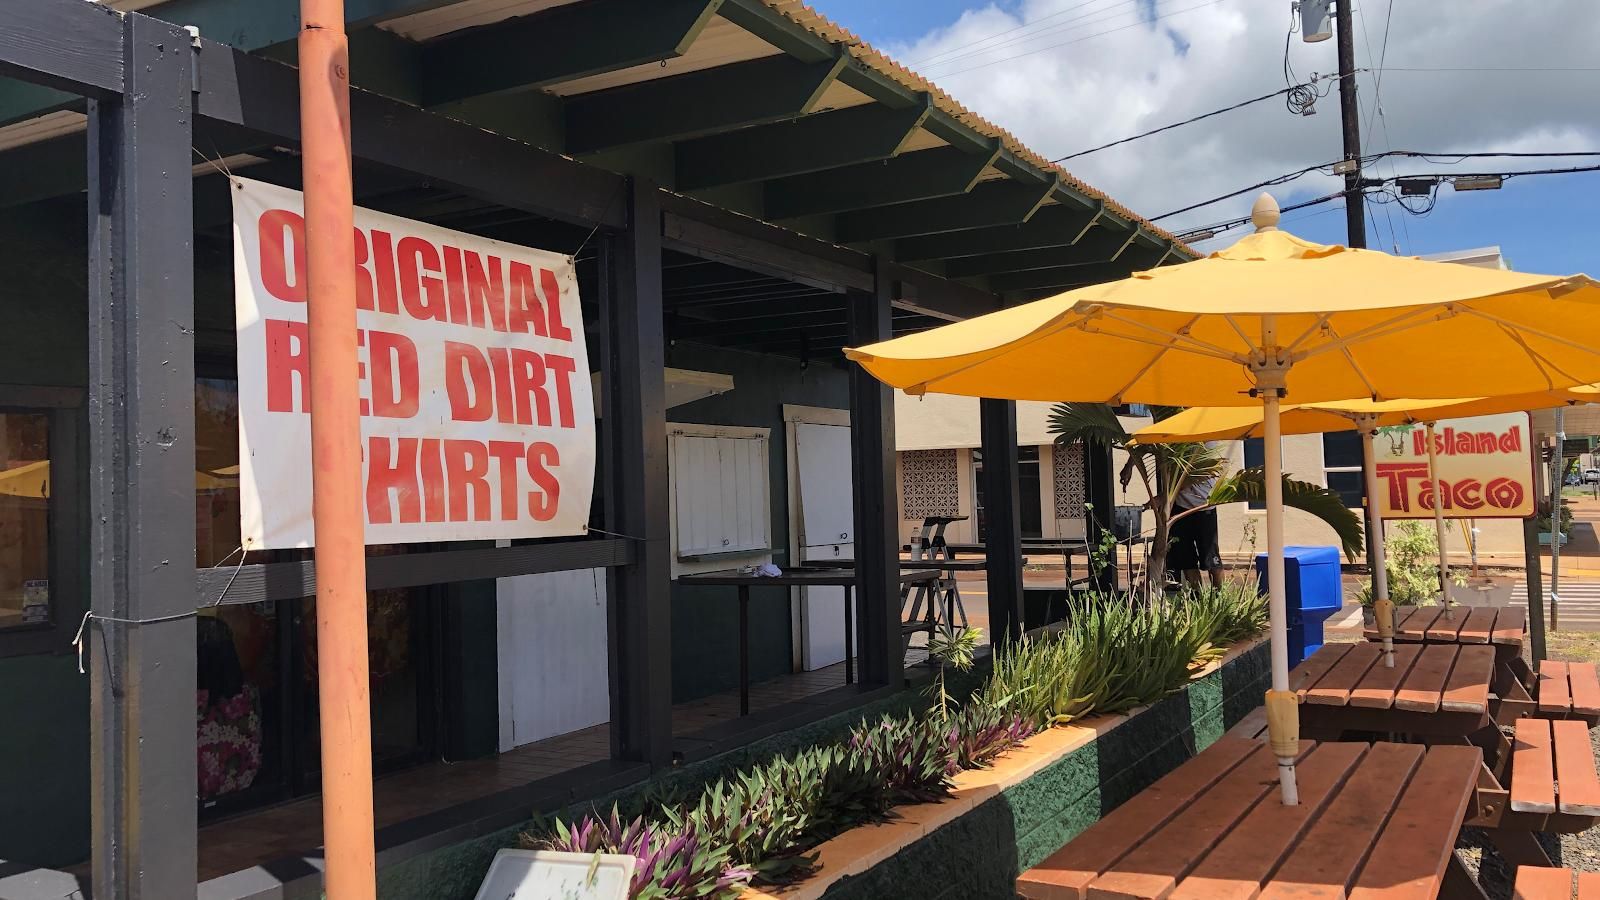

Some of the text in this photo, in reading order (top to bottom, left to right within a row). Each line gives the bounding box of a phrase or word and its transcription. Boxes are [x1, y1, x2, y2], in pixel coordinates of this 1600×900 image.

[265, 319, 576, 429] RD DIRT
[1413, 424, 1522, 456] Island
[312, 436, 561, 525] HIRTS
[1376, 462, 1524, 513] Taco
